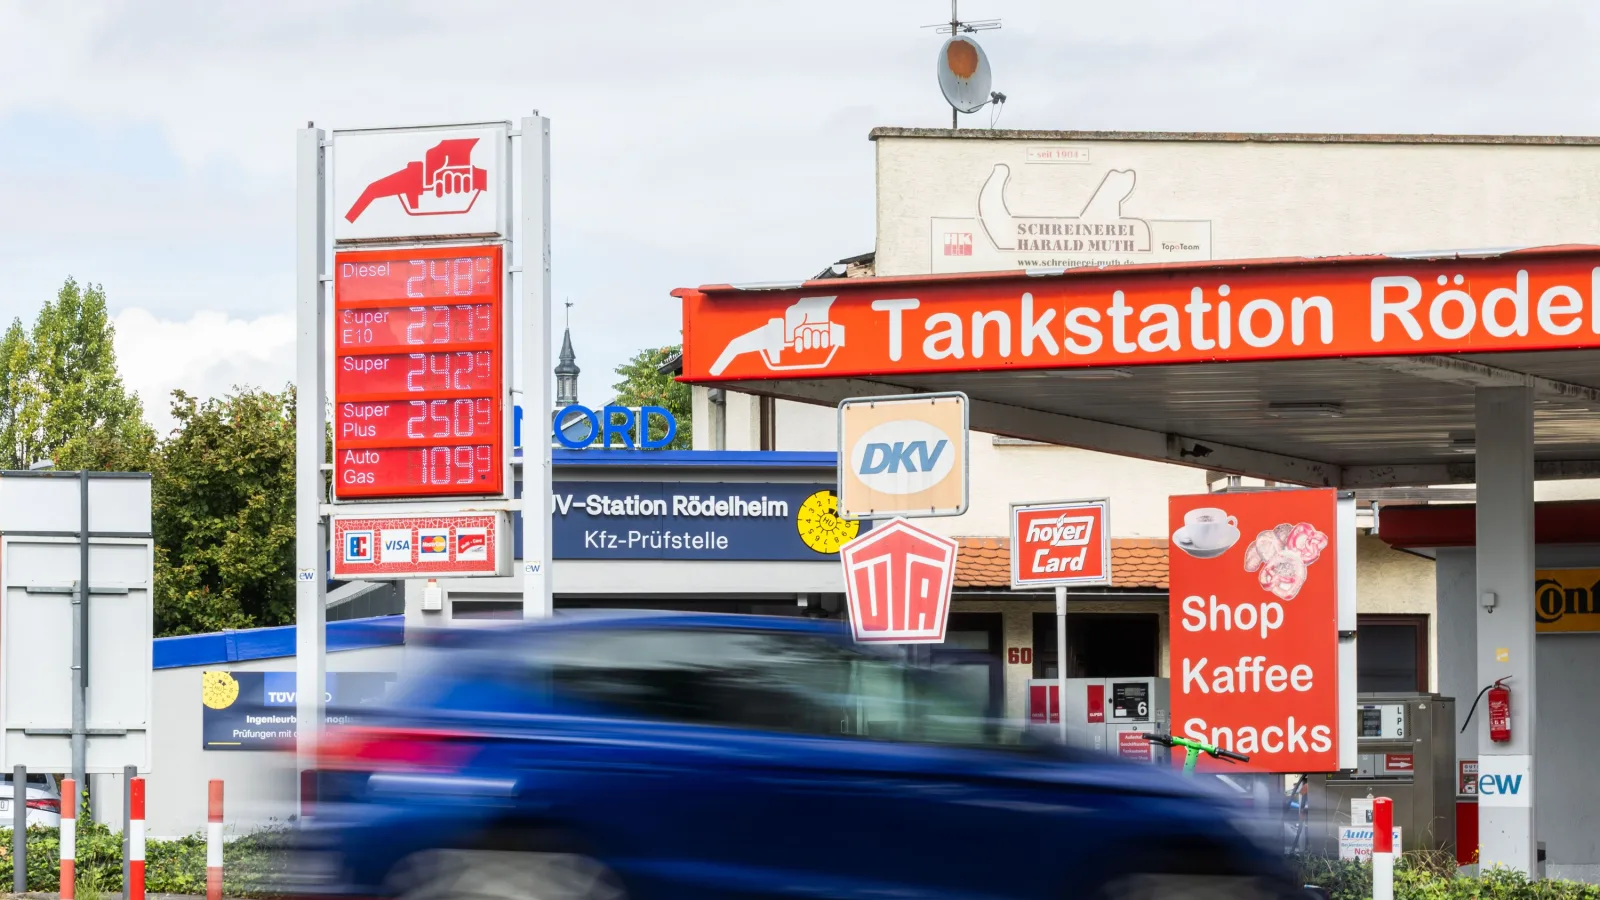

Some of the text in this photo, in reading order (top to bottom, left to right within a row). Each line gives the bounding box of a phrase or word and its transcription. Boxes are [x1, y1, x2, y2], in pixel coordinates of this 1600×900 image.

[1017, 223, 1135, 236] SCHREINEREI
[1017, 238, 1135, 252] HARALD MUTH
[343, 262, 390, 278] Diesel
[1017, 258, 1136, 268] www.schreinerei-muthde
[343, 309, 389, 327] Super
[871, 284, 1334, 362] Tankstation
[343, 328, 373, 344] E10
[343, 356, 389, 374] Super
[343, 403, 390, 420] Super
[343, 423, 376, 438] Plus
[344, 449, 380, 465] Auto
[859, 439, 949, 475] DKV
[343, 469, 375, 484] Gas
[521, 490, 789, 518] V-Station Rödelheim
[1026, 516, 1093, 546] hoyer
[385, 540, 410, 551] VISA
[584, 530, 729, 550] Kfz-Prüfstelle
[525, 562, 541, 574] ew
[1031, 548, 1087, 574] Card
[299, 570, 314, 581] ew
[1182, 594, 1285, 639] Shop
[1008, 647, 1031, 664] 60
[1182, 655, 1314, 694] Kaffee
[1137, 701, 1147, 716] 6
[246, 715, 298, 726] Ingenieurb
[232, 729, 276, 740] Prüfungen
[278, 729, 292, 739] mit
[1183, 715, 1332, 754] Snacks
[1479, 773, 1523, 795] ew
